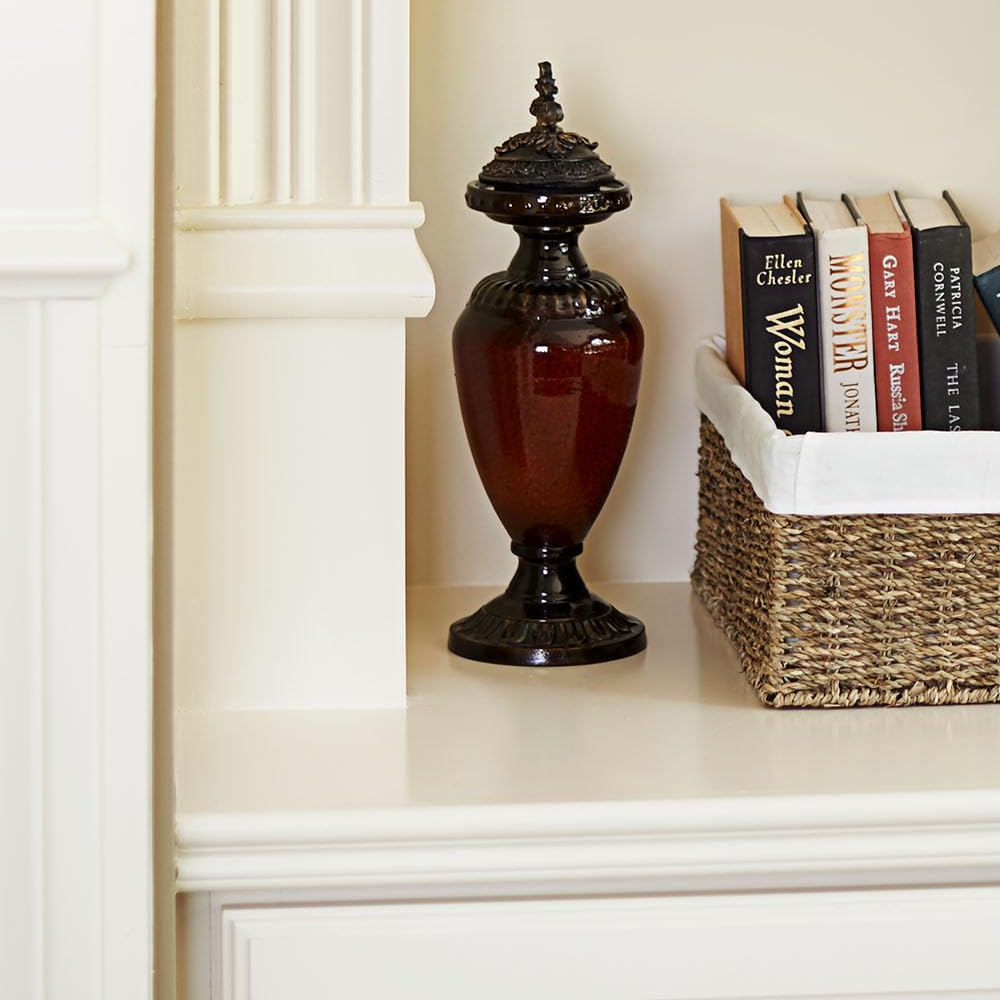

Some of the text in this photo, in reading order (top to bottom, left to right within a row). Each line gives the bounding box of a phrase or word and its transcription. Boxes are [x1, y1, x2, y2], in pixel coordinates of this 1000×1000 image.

[756, 271, 812, 286] Chesler
[765, 254, 804, 270] Ellen
[882, 254, 898, 299] GARY
[829, 252, 869, 374] MONSTER
[933, 262, 947, 337] CORNWELL
[950, 267, 963, 329] PATRICIA
[885, 305, 901, 352] HART
[765, 303, 806, 418] Woman
[946, 362, 960, 396] THE
[889, 362, 907, 412] Russia
